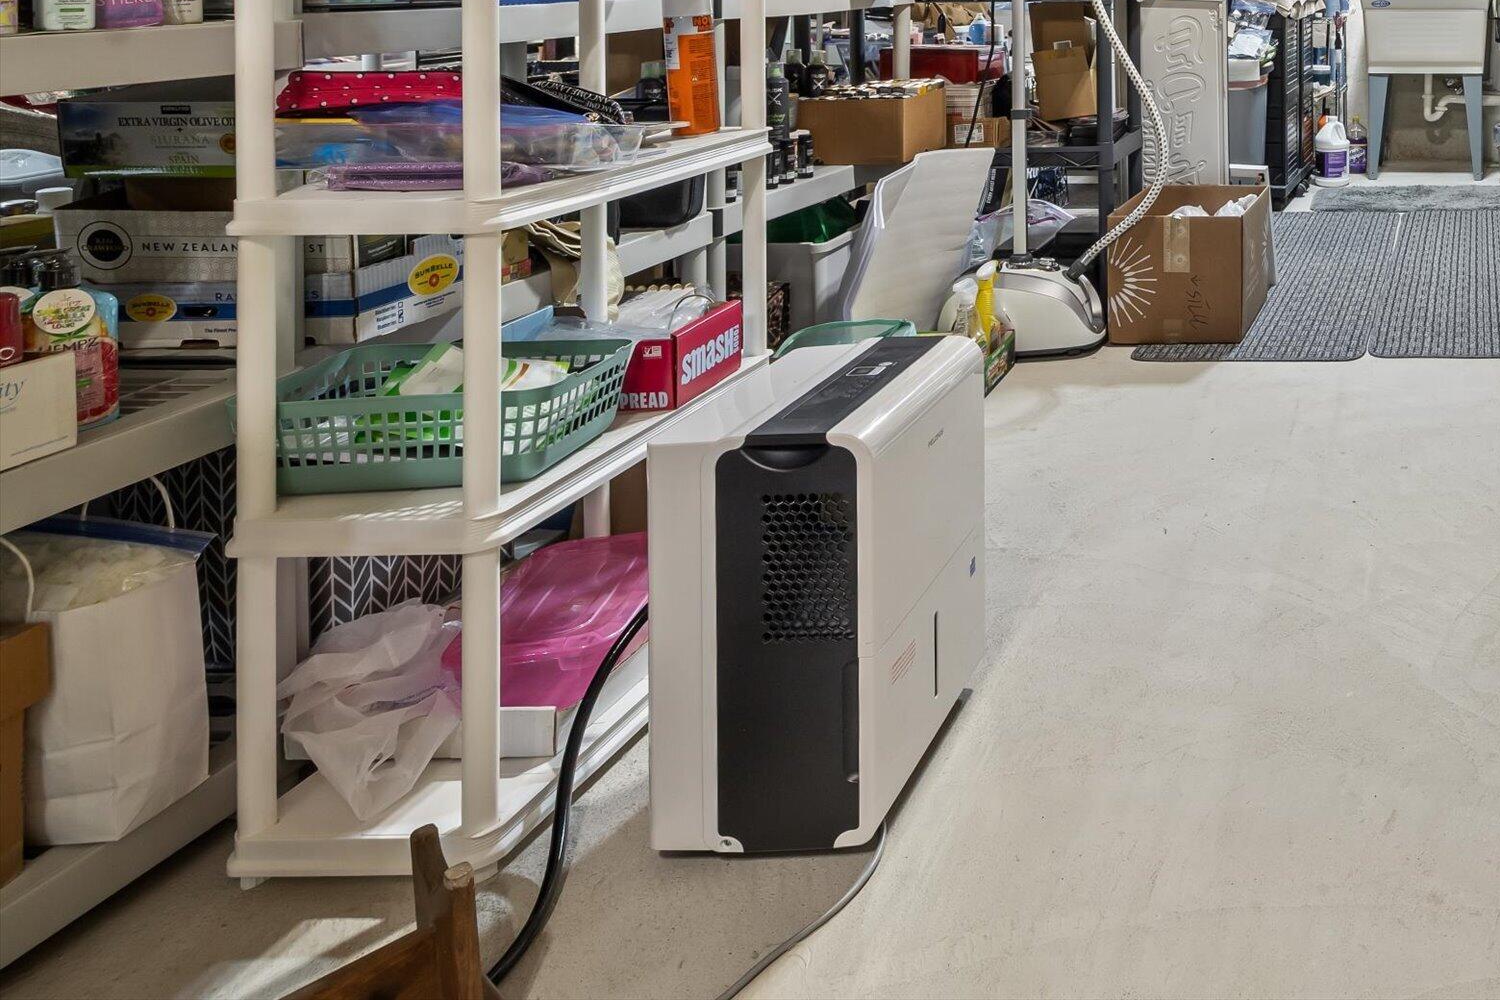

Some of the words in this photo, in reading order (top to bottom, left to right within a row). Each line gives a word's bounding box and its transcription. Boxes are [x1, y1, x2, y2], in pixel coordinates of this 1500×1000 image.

[118, 117, 150, 127] EXTRA
[152, 117, 187, 127] VIRGIN
[189, 117, 220, 127] OLIVE
[168, 154, 199, 164] SPAIN
[142, 243, 177, 252] NEW
[183, 242, 238, 252] ZEALAN
[620, 391, 669, 410] PREAD
